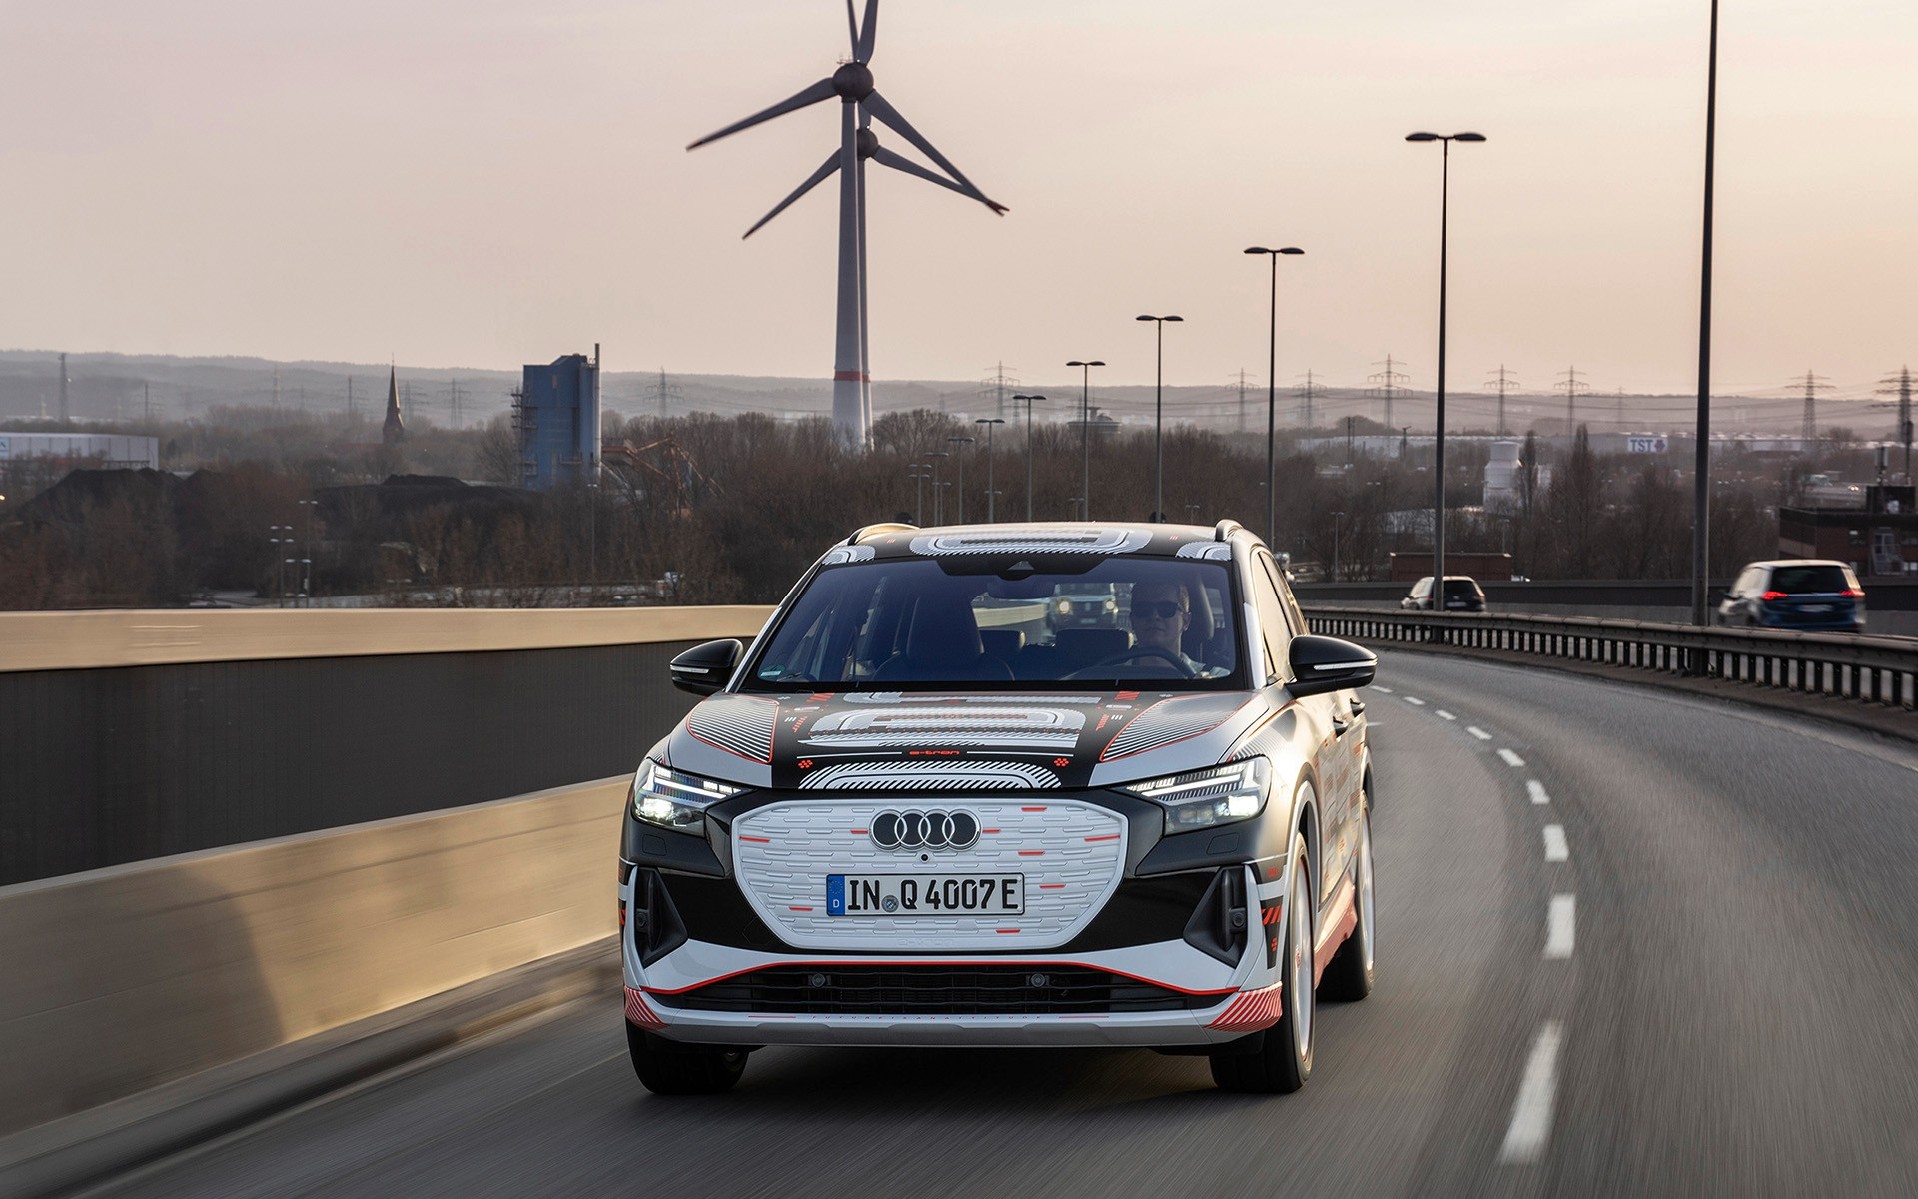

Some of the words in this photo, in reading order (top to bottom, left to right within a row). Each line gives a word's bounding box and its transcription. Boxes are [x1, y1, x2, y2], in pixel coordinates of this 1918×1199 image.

[1630, 439, 1653, 452] TST
[848, 880, 880, 910] IN
[900, 879, 917, 909] Q
[833, 899, 840, 908] D
